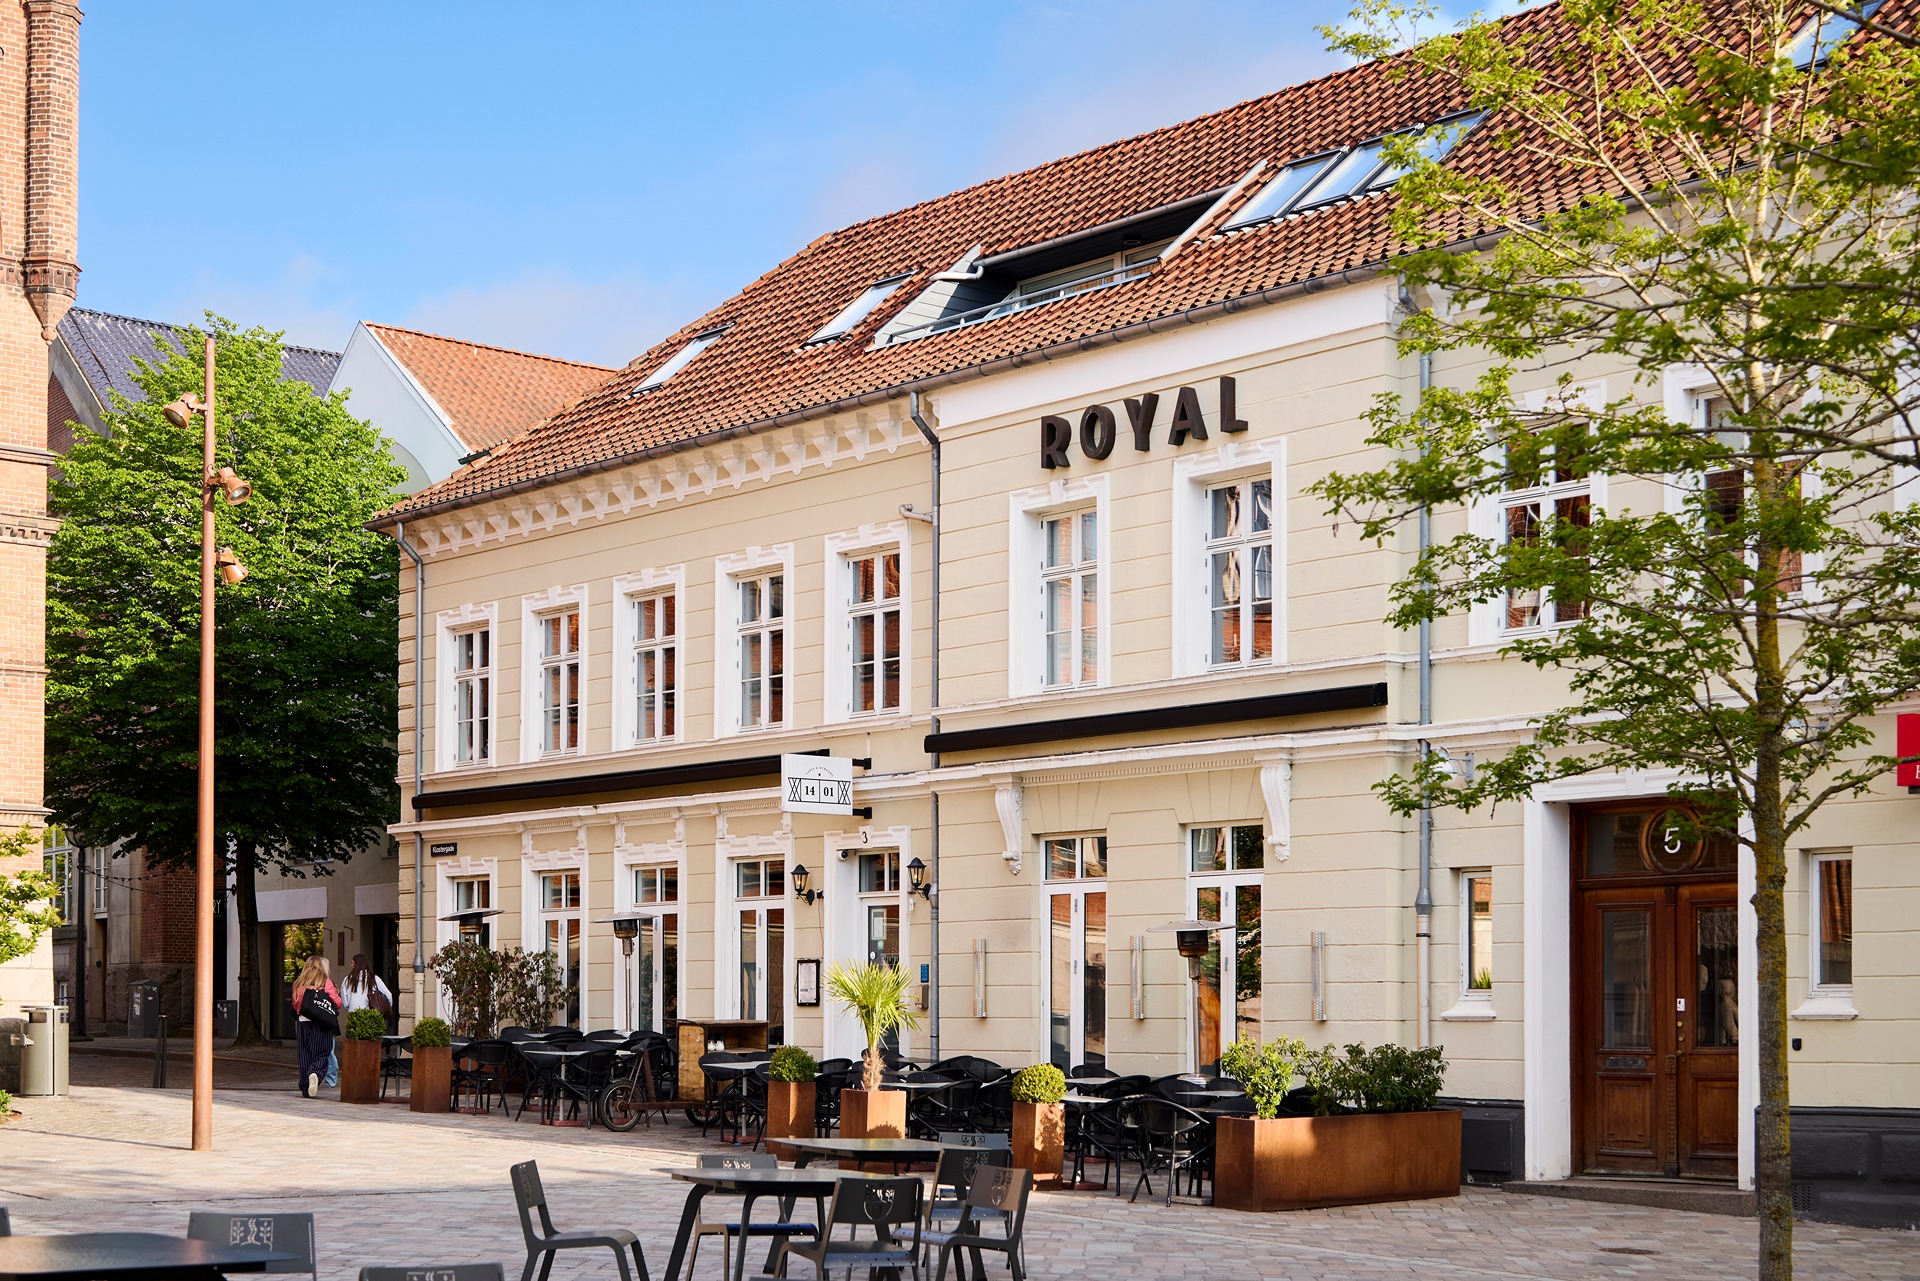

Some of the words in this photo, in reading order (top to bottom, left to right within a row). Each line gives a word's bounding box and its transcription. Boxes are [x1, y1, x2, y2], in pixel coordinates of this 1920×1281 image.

[1041, 376, 1249, 469] ROYAL
[805, 786, 815, 796] 14
[823, 787, 834, 797] 01
[862, 831, 869, 844] 3
[1664, 827, 1681, 854] 5
[432, 844, 455, 854] Klostergade
